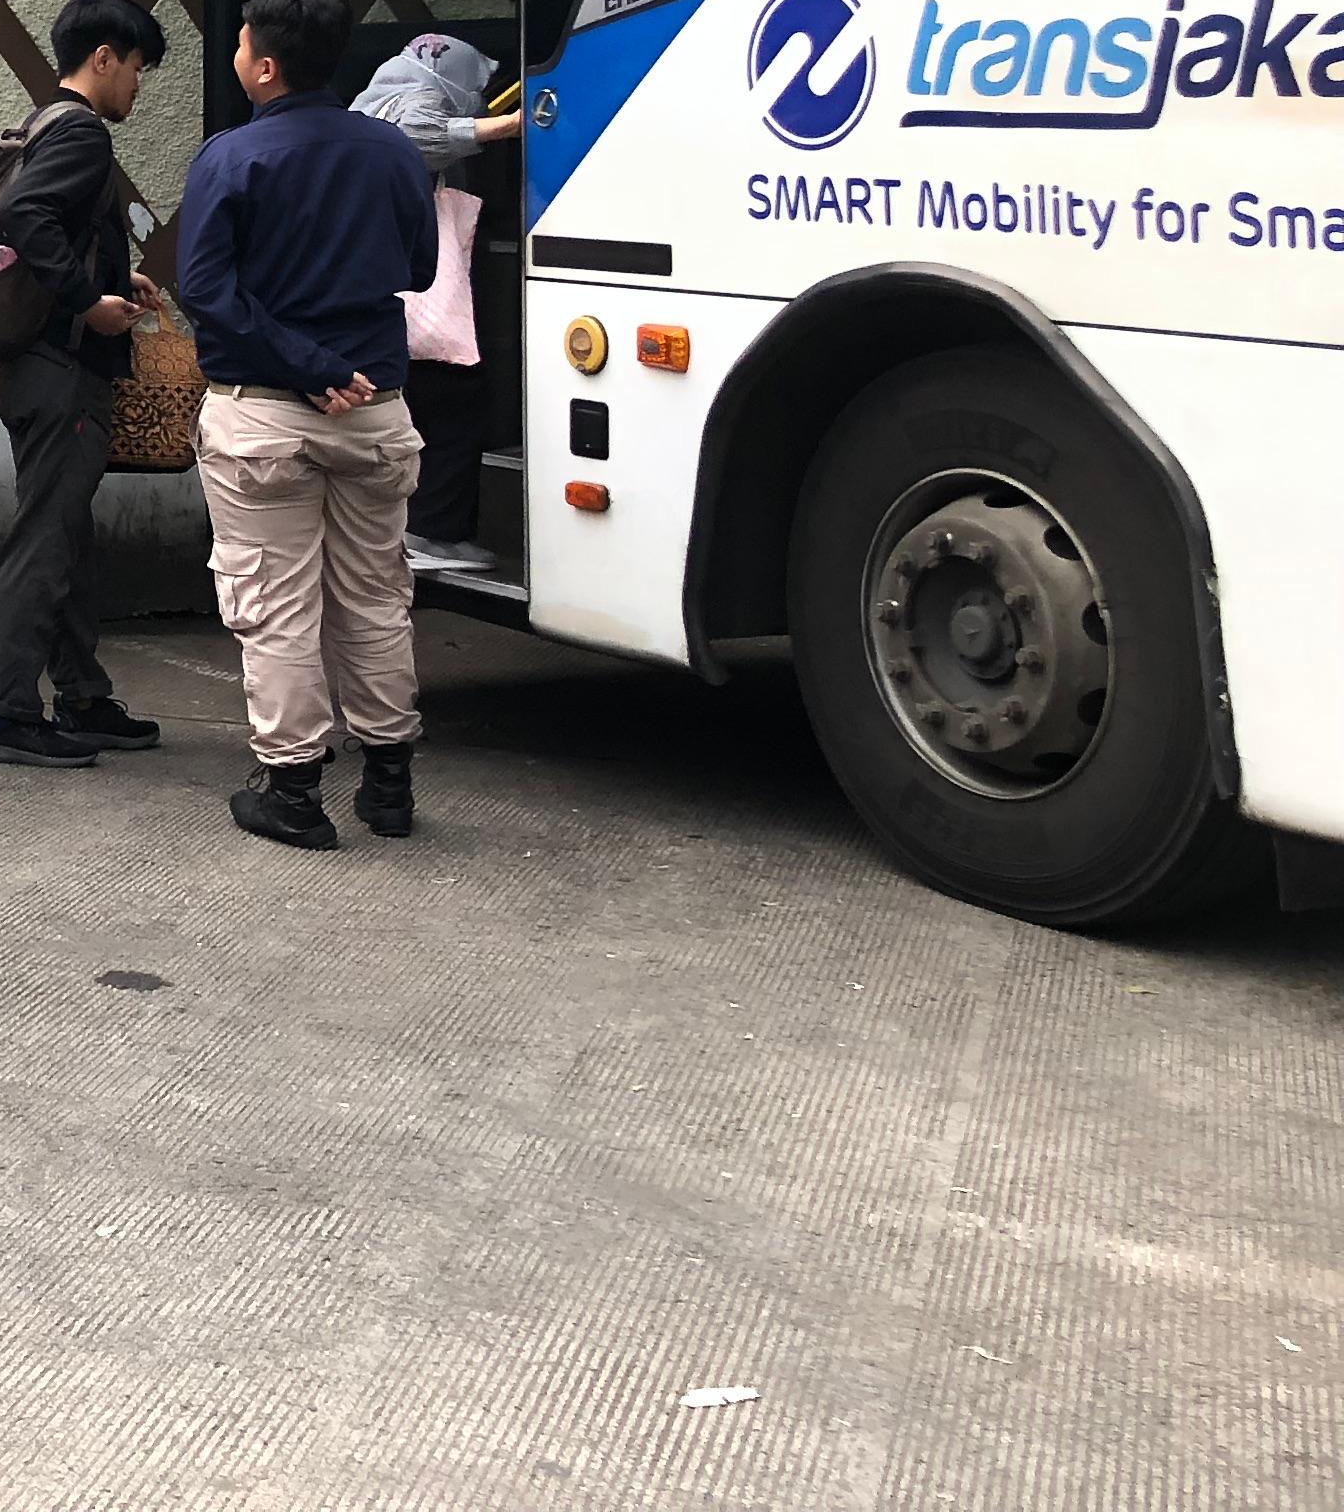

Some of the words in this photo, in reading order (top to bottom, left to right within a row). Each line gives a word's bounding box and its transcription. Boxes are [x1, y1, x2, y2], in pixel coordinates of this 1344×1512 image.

[747, 174, 901, 226] SMART
[917, 180, 1116, 251] Mobility
[1133, 188, 1210, 243] for
[1228, 192, 1344, 251] Sma
